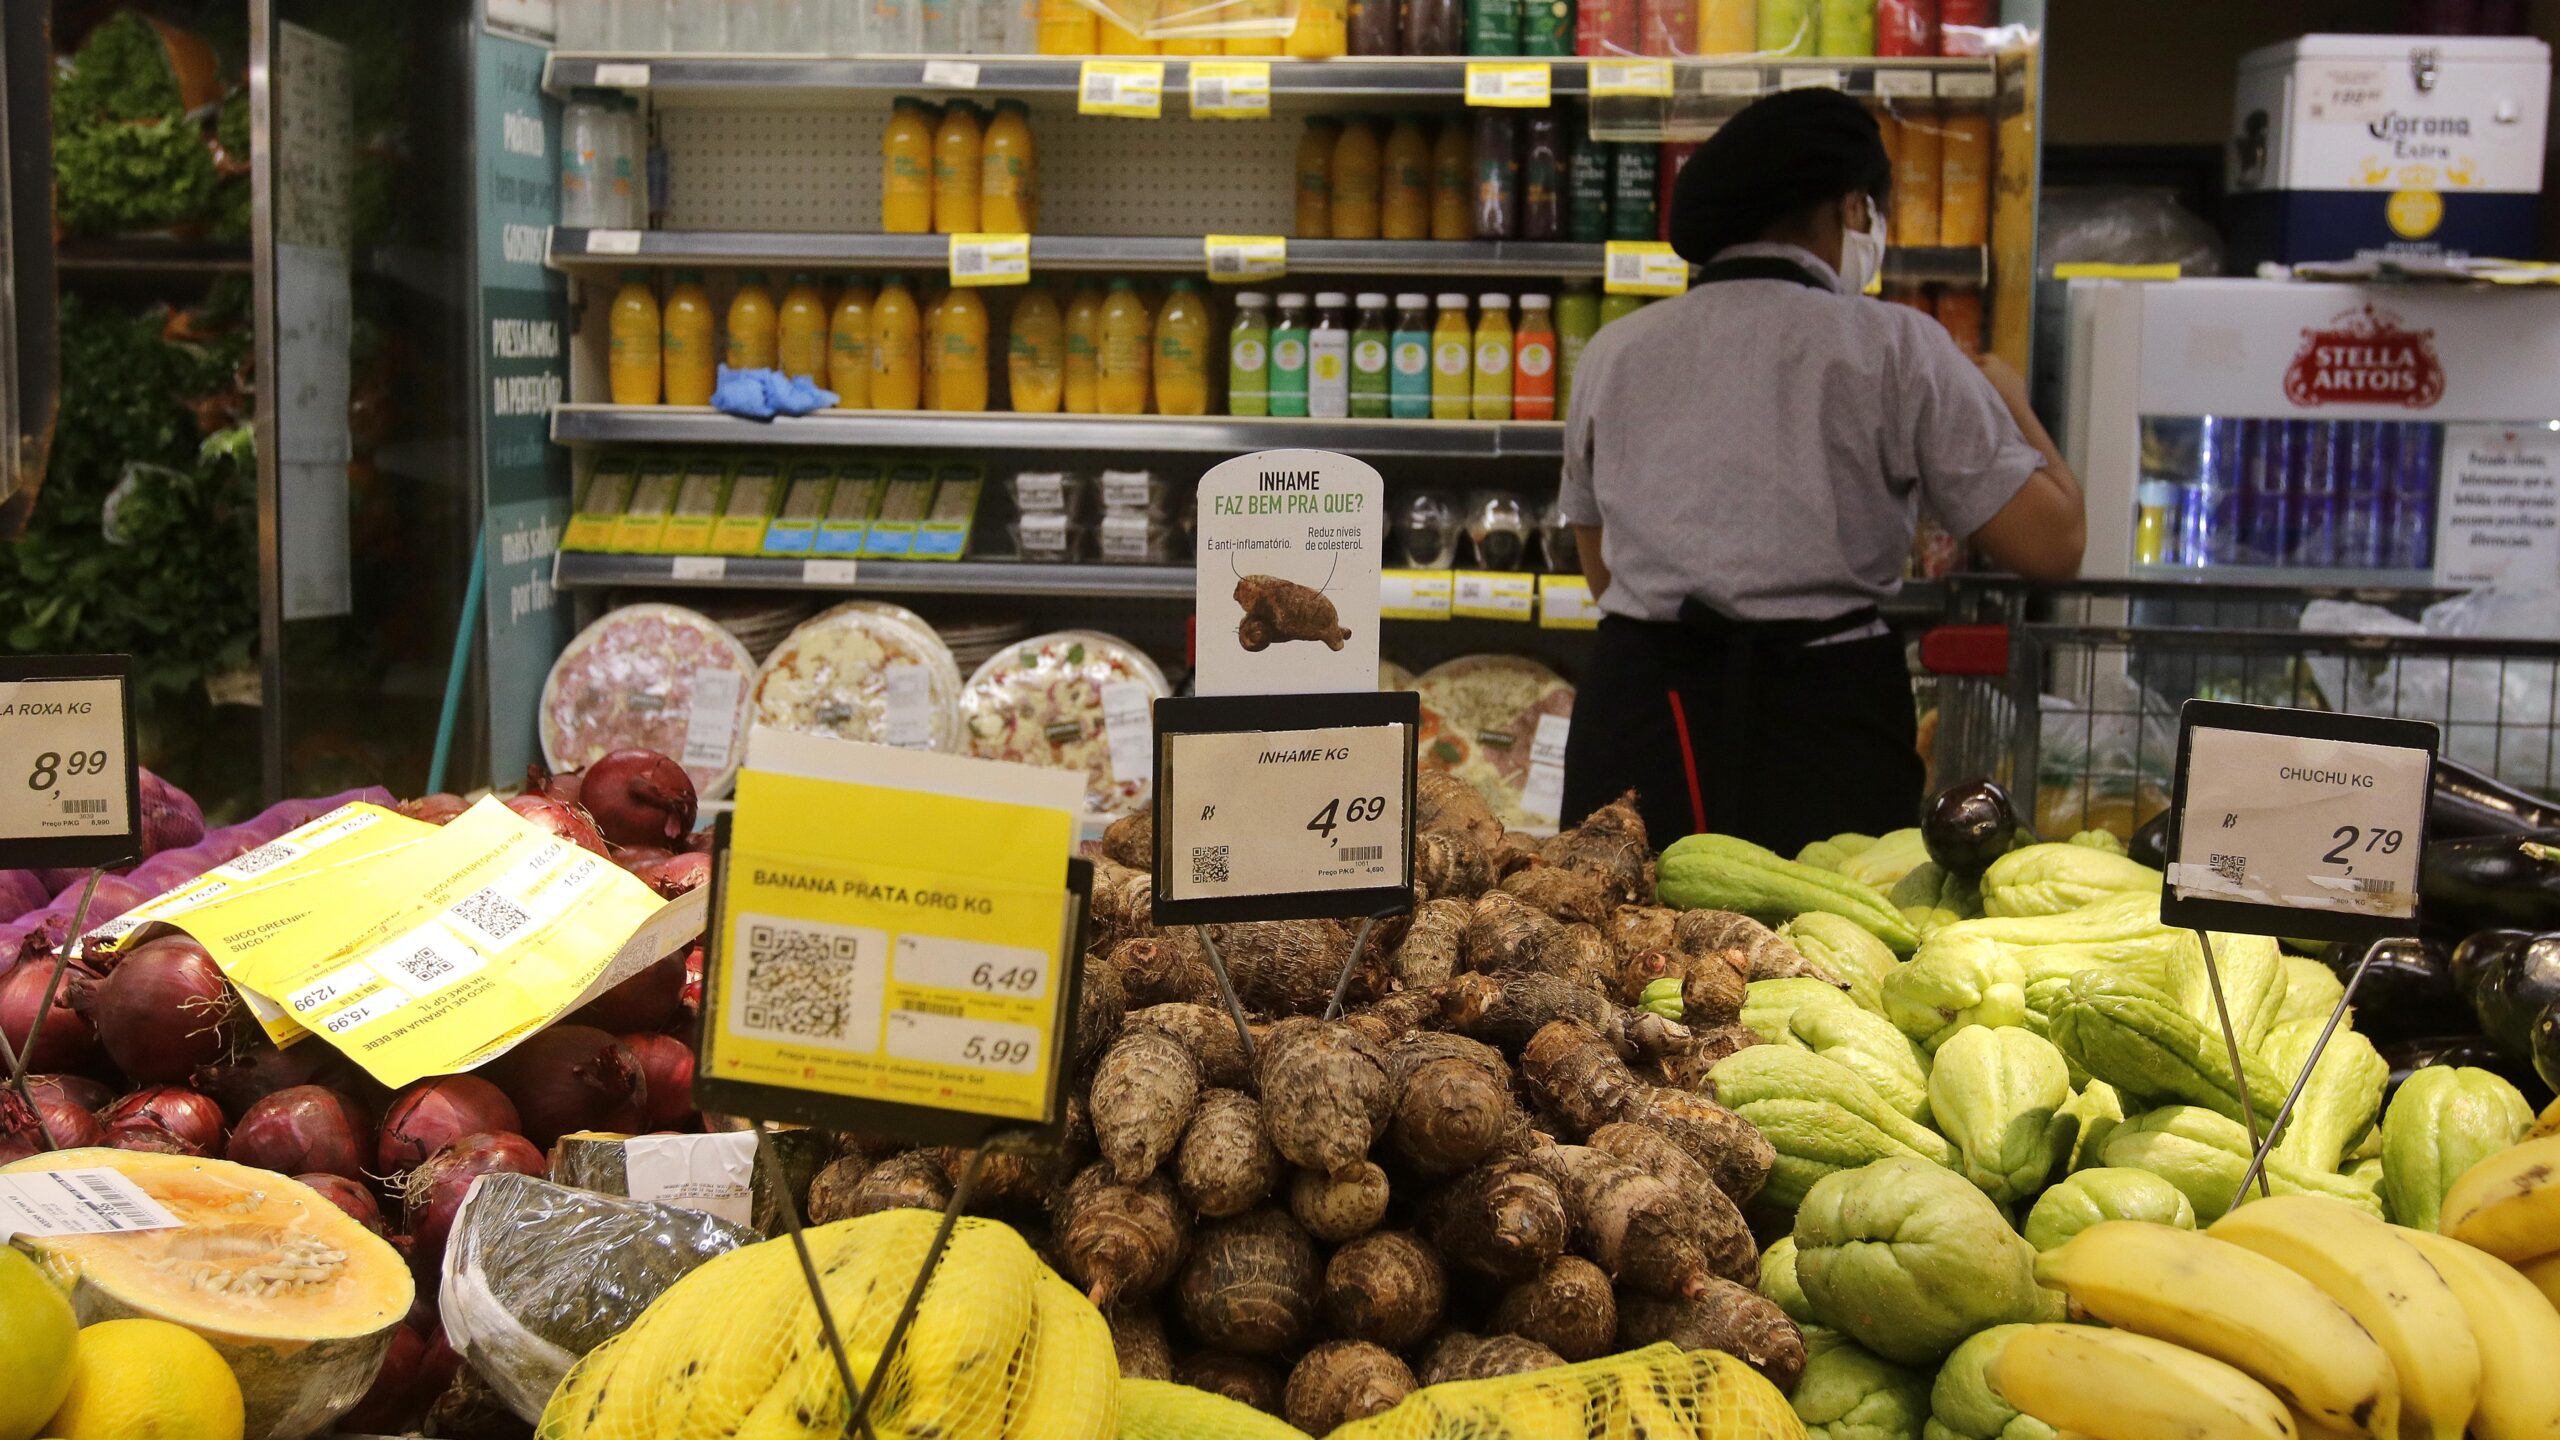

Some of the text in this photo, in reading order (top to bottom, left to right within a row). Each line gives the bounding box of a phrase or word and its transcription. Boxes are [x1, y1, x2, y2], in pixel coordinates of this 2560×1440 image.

[2369, 109, 2471, 139] Corona
[2393, 140, 2450, 159] Extra
[2315, 346, 2416, 368] STELLA
[2313, 368, 2417, 390] ARTOIS
[1259, 471, 1320, 491] INHAME
[1215, 493, 1364, 515] FAZ BEM PRA QUE?
[1308, 526, 1361, 537] Reduz níveis
[1207, 538, 1292, 550] É anti-inflamatório.
[1305, 540, 1316, 550] de
[19, 703, 63, 716] ROXA
[67, 702, 92, 715] KG
[1258, 747, 1349, 764] INHAME KG
[28, 751, 107, 800] 8,99
[2279, 767, 2374, 788] CHUCHU KG
[1200, 805, 1216, 821] R$
[1306, 796, 1386, 848] 4,69
[2222, 813, 2237, 829] R$
[2322, 825, 2403, 876] 2,79
[563, 858, 597, 887] 15,59
[753, 870, 993, 915] BANANA PRATA ORG KG
[223, 928, 256, 944] SUCO
[230, 937, 264, 952] SUCO
[971, 962, 1038, 991] 6,49
[295, 984, 337, 1013] 12,99
[446, 983, 471, 998] BIKE
[327, 1007, 371, 1033] 15,99
[362, 981, 496, 1051] SUCO DE LARANJA ME BEBE
[963, 1035, 1030, 1065] 5,99
